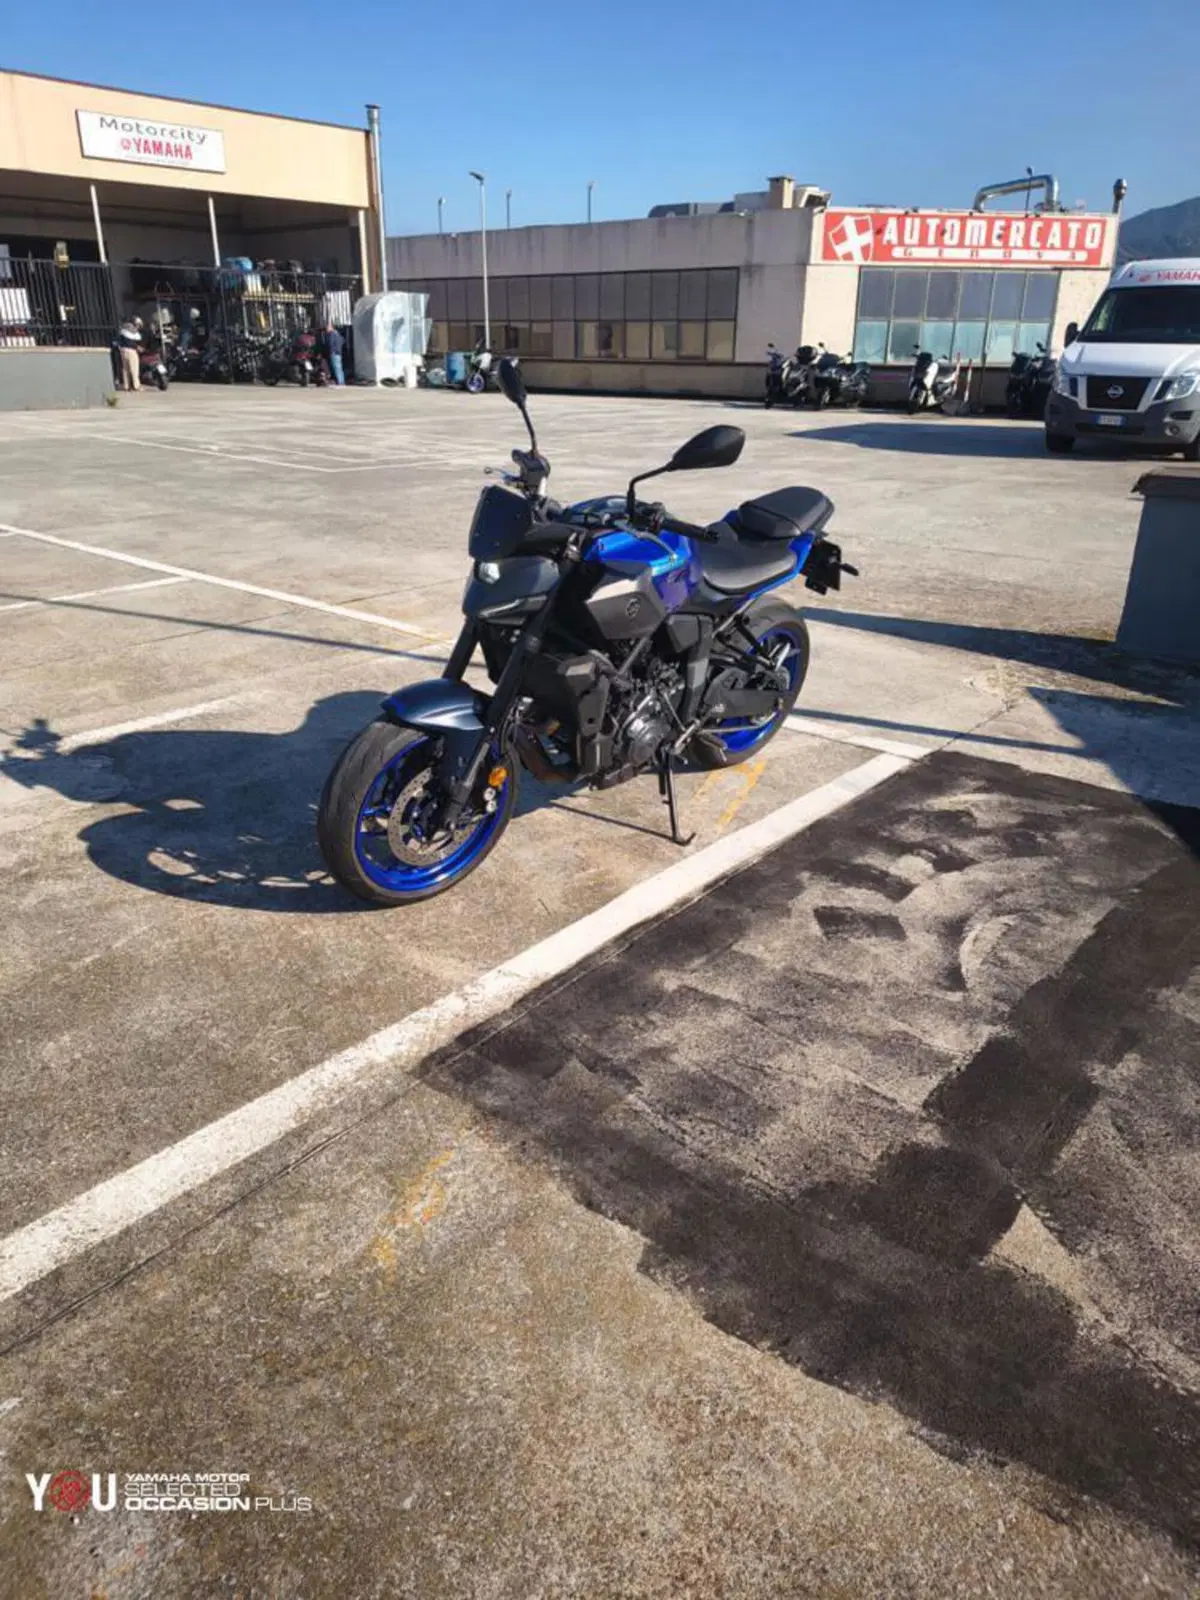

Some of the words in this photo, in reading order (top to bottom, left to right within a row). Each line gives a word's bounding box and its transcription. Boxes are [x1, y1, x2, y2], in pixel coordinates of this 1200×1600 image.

[100, 117, 206, 145] Motorcity
[133, 137, 193, 160] YAMAHA
[882, 216, 1102, 250] AUTOMERCATO
